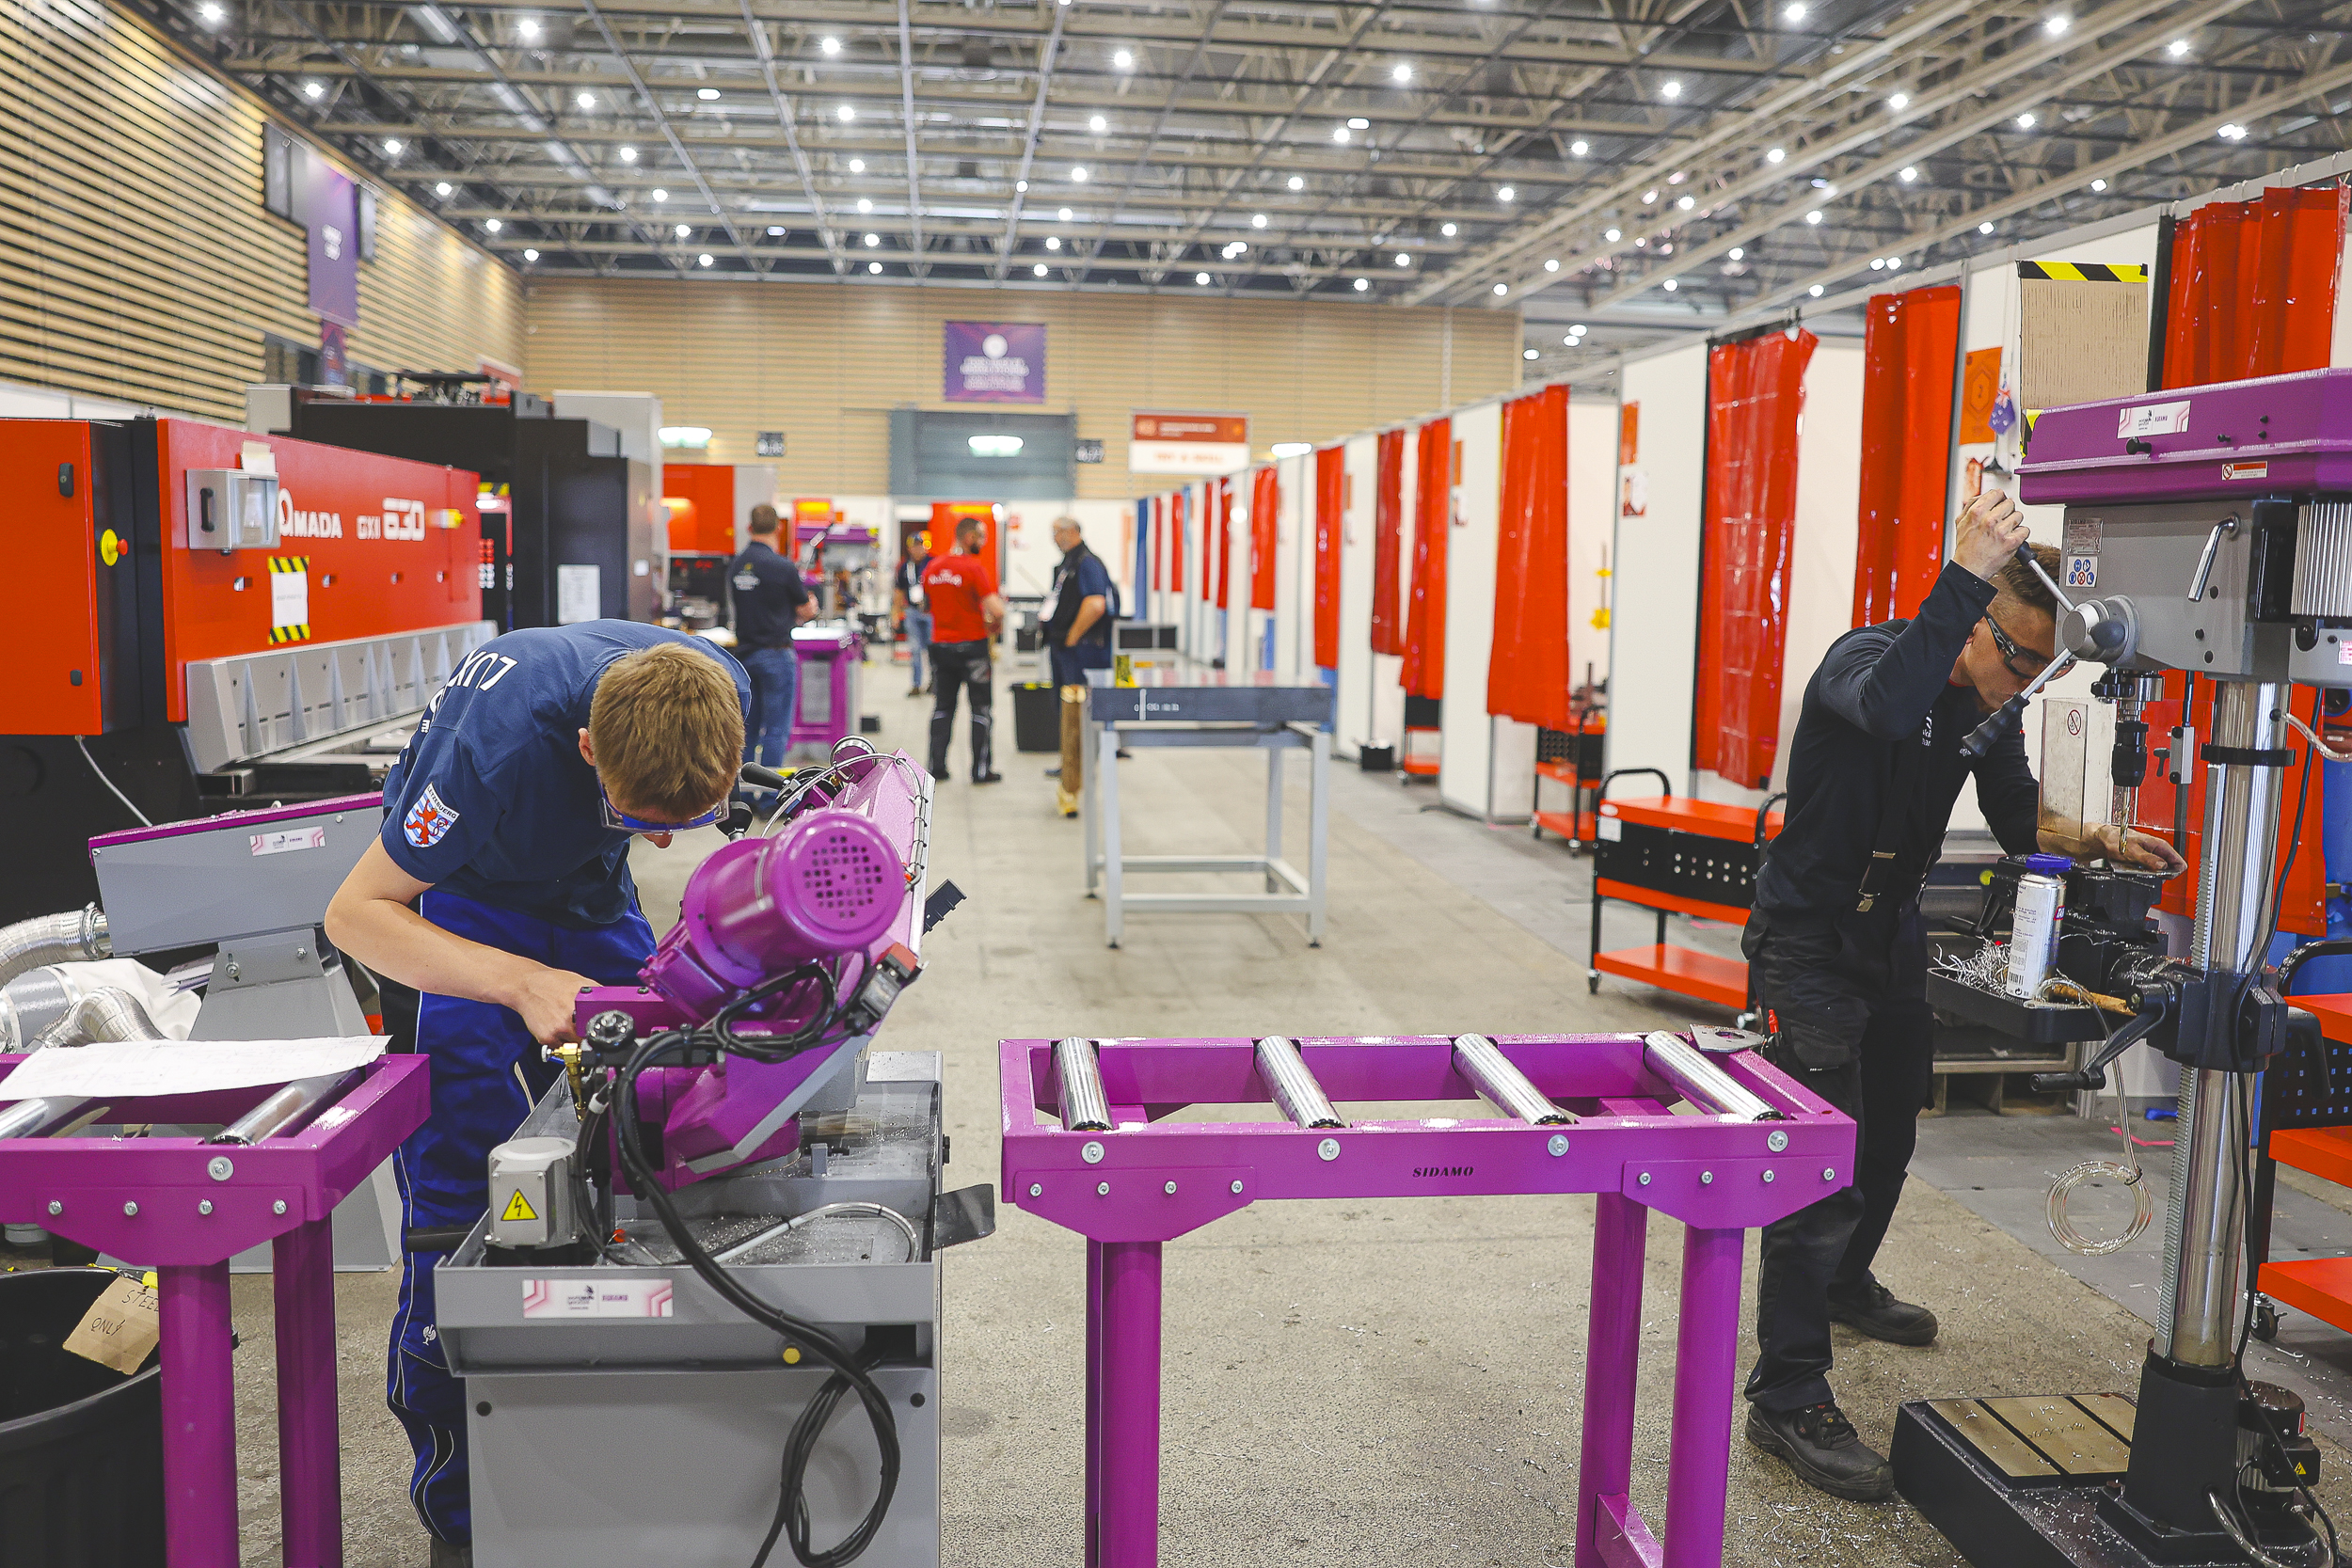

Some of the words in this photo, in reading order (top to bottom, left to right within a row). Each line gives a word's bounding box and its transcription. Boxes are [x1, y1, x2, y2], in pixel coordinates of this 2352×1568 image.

[382, 498, 425, 541] 630
[1412, 1166, 1474, 1178] SIDAMO
[91, 1317, 126, 1337] ONLY
